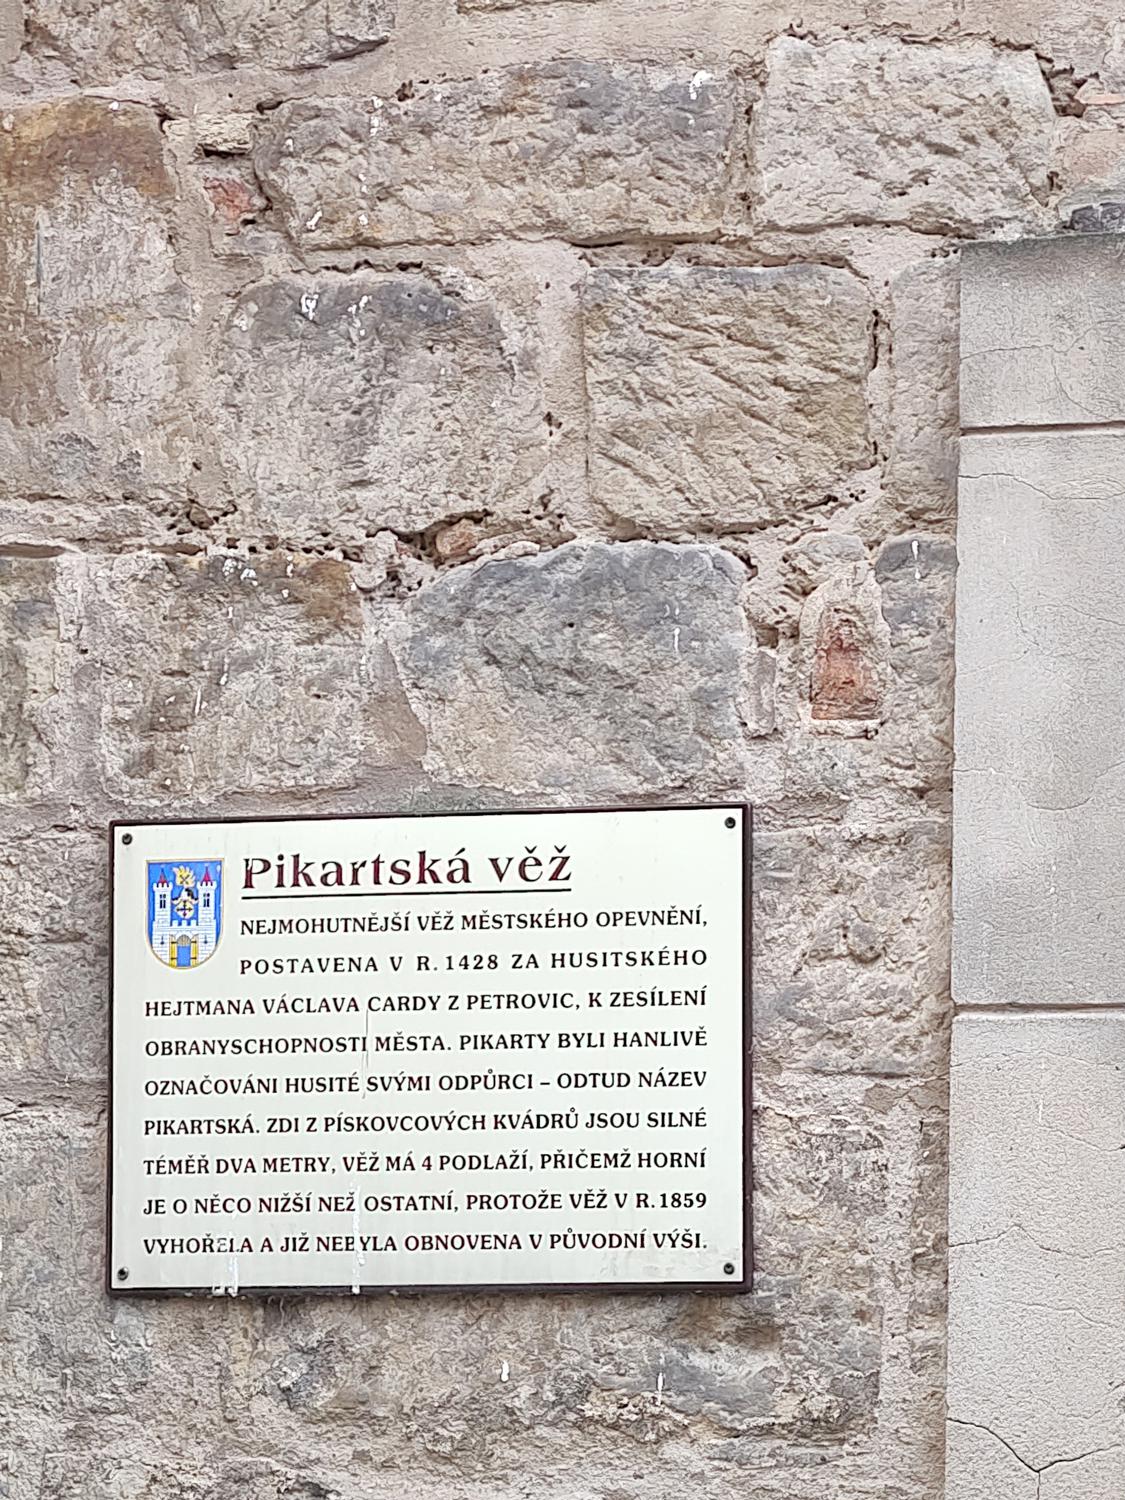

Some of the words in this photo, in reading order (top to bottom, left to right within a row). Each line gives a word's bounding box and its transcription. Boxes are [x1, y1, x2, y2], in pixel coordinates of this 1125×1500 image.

[240, 847, 472, 889] Pikartská
[488, 844, 572, 883] věž
[240, 911, 411, 936] NEJMOHUTNĚJŠÍ
[416, 910, 455, 932] VĚŽ
[461, 907, 589, 930] MĚSTSKÉHO
[595, 904, 707, 927] OPEVNĚNÍ,
[240, 956, 378, 975] POSTAVENA
[389, 956, 403, 972] V
[511, 953, 540, 970] ZA
[551, 945, 707, 969] HUSITSKÉHO
[145, 999, 256, 1017] HEJTMANA
[262, 993, 360, 1014] VÁCLAVA
[367, 995, 441, 1012] CARDY
[448, 995, 460, 1011] Z
[466, 992, 580, 1010] PETROVIC,
[588, 992, 603, 1008] K
[609, 984, 708, 1008] ZESÍLENÍ
[145, 1036, 367, 1055] OBRANYSCHOPNOSTI
[375, 1031, 452, 1052] MĚSTA.
[459, 1033, 551, 1051] PIKARTY
[557, 1032, 605, 1049] BYLI
[613, 1026, 708, 1048] HANLIVĚ
[144, 1073, 278, 1097] OZNAČOVÁNI
[285, 1071, 360, 1094] HUSITÉ
[366, 1071, 431, 1092] SVÝMI
[438, 1068, 533, 1091] ODPŮRCI
[556, 1072, 631, 1089] ODTUD
[638, 1066, 707, 1088] NÁZEV
[144, 1113, 260, 1136] PIKARTSKÁ.
[266, 1117, 299, 1133] ZDI
[306, 1117, 318, 1133] Z
[324, 1110, 486, 1133] PÍSKOVCOVÝCH
[493, 1106, 579, 1130] KVÁDRŮ
[585, 1112, 640, 1129] JSOU
[646, 1106, 707, 1128] SILNÉ
[143, 1154, 210, 1175] TÉMĚŘ
[215, 1158, 257, 1174] DVA
[262, 1156, 336, 1174] METRY,
[342, 1151, 380, 1172] VĚŽ
[385, 1151, 416, 1172] MÁ
[421, 1155, 433, 1171] 4
[439, 1149, 534, 1171] PODLAŽÍ,
[540, 1148, 632, 1170] PŘIČEMŽ
[637, 1147, 707, 1168] HORNÍ
[143, 1199, 166, 1215] JE
[172, 1198, 188, 1215] O
[194, 1193, 252, 1214] NĚCO
[258, 1191, 312, 1213] NIŽŠÍ
[318, 1191, 356, 1212] NEŽ
[364, 1190, 459, 1213] OSTATNÍ,
[466, 1189, 563, 1210] PROTOŽE
[569, 1188, 608, 1209] VĚŽ
[614, 1193, 628, 1209] V
[260, 1237, 274, 1253] A
[279, 1232, 310, 1253] JIŽ
[404, 1234, 522, 1252] OBNOVENA
[528, 1233, 543, 1250] V
[549, 1227, 647, 1250] PŮVODNÍ
[652, 1228, 707, 1249] VÝŠI.
